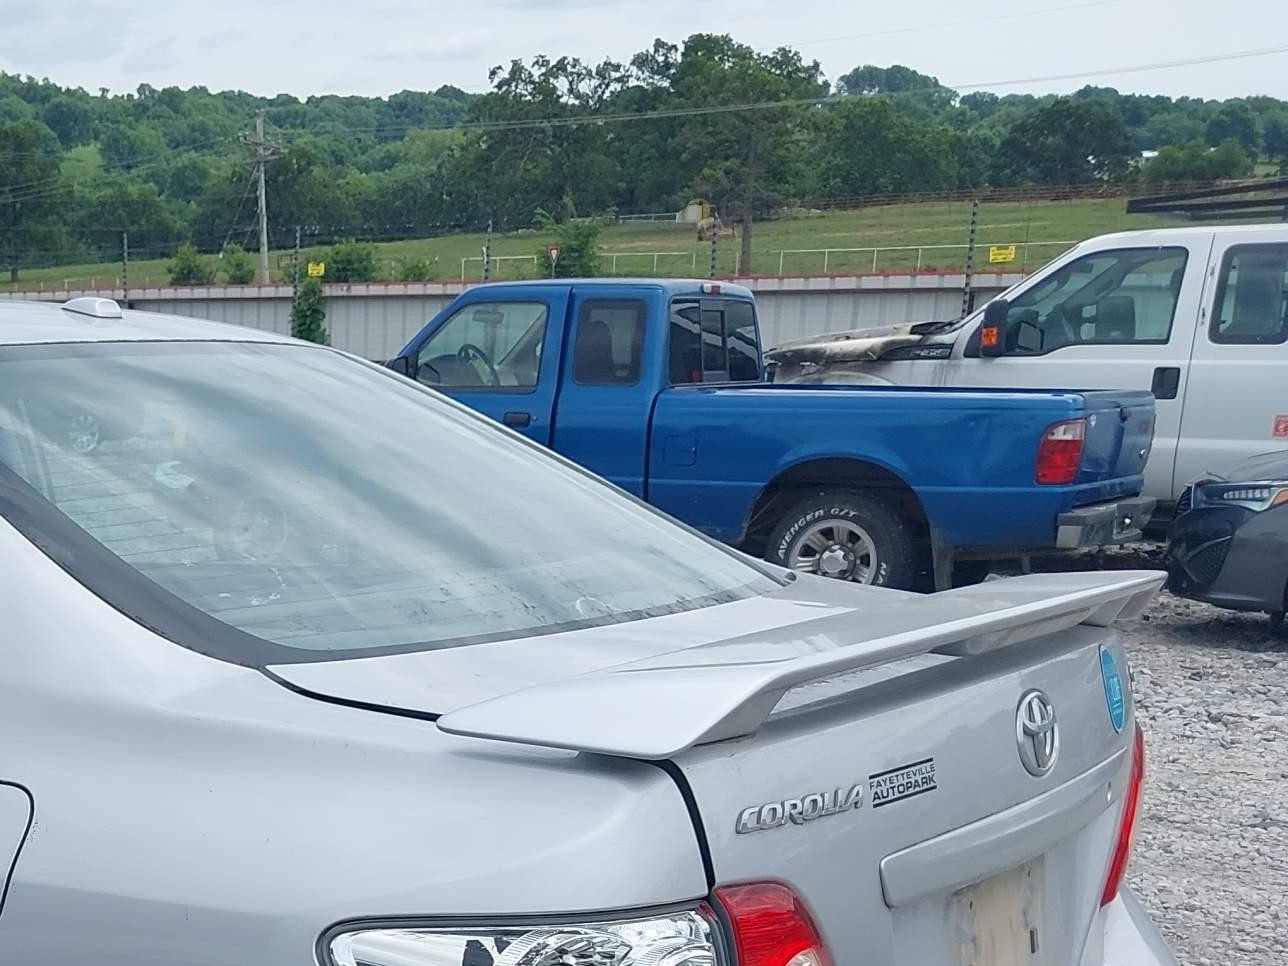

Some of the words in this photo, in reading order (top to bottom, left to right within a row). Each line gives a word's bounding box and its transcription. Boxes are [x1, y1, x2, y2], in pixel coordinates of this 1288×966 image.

[777, 508, 825, 560] AVENGER
[830, 507, 859, 519] G/T
[868, 763, 936, 791] FAYETTEVILLE
[871, 774, 937, 803] AUTOPARK
[735, 783, 864, 835] COROLLA
